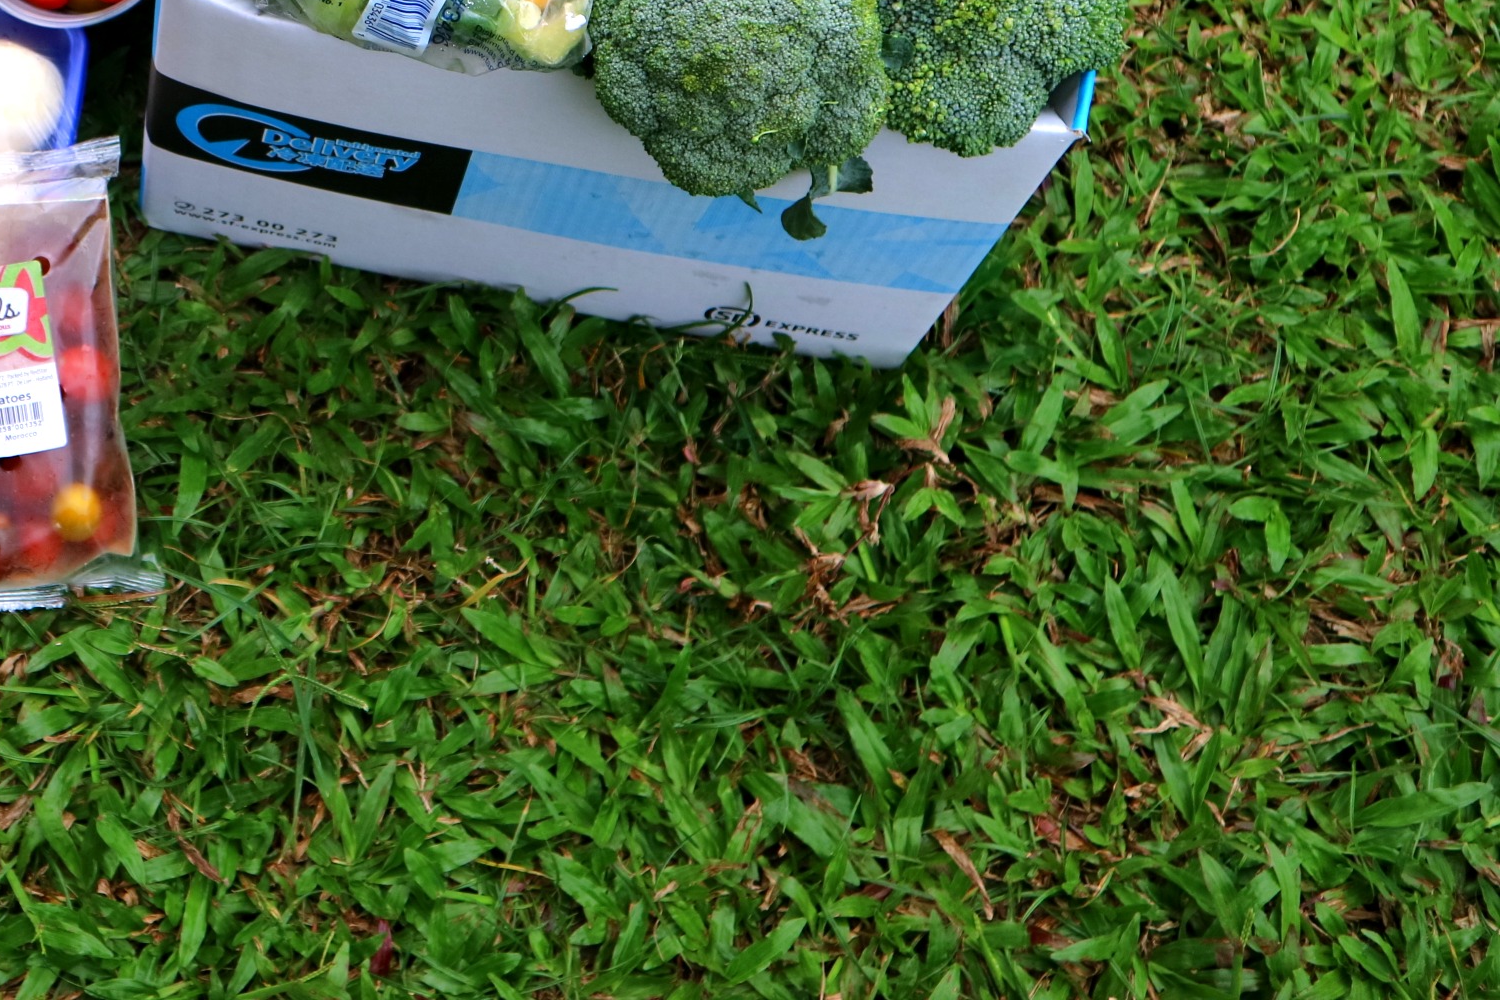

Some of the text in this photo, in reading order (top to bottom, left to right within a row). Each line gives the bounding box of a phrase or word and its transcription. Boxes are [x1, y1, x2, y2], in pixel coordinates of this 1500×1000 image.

[364, 2, 385, 27] 03436
[261, 128, 421, 173] Delivery
[174, 209, 337, 249] www.sf-express.com
[203, 206, 338, 244] 273 00 273
[765, 320, 860, 342] EXPRESS
[4, 430, 38, 441] Morocco
